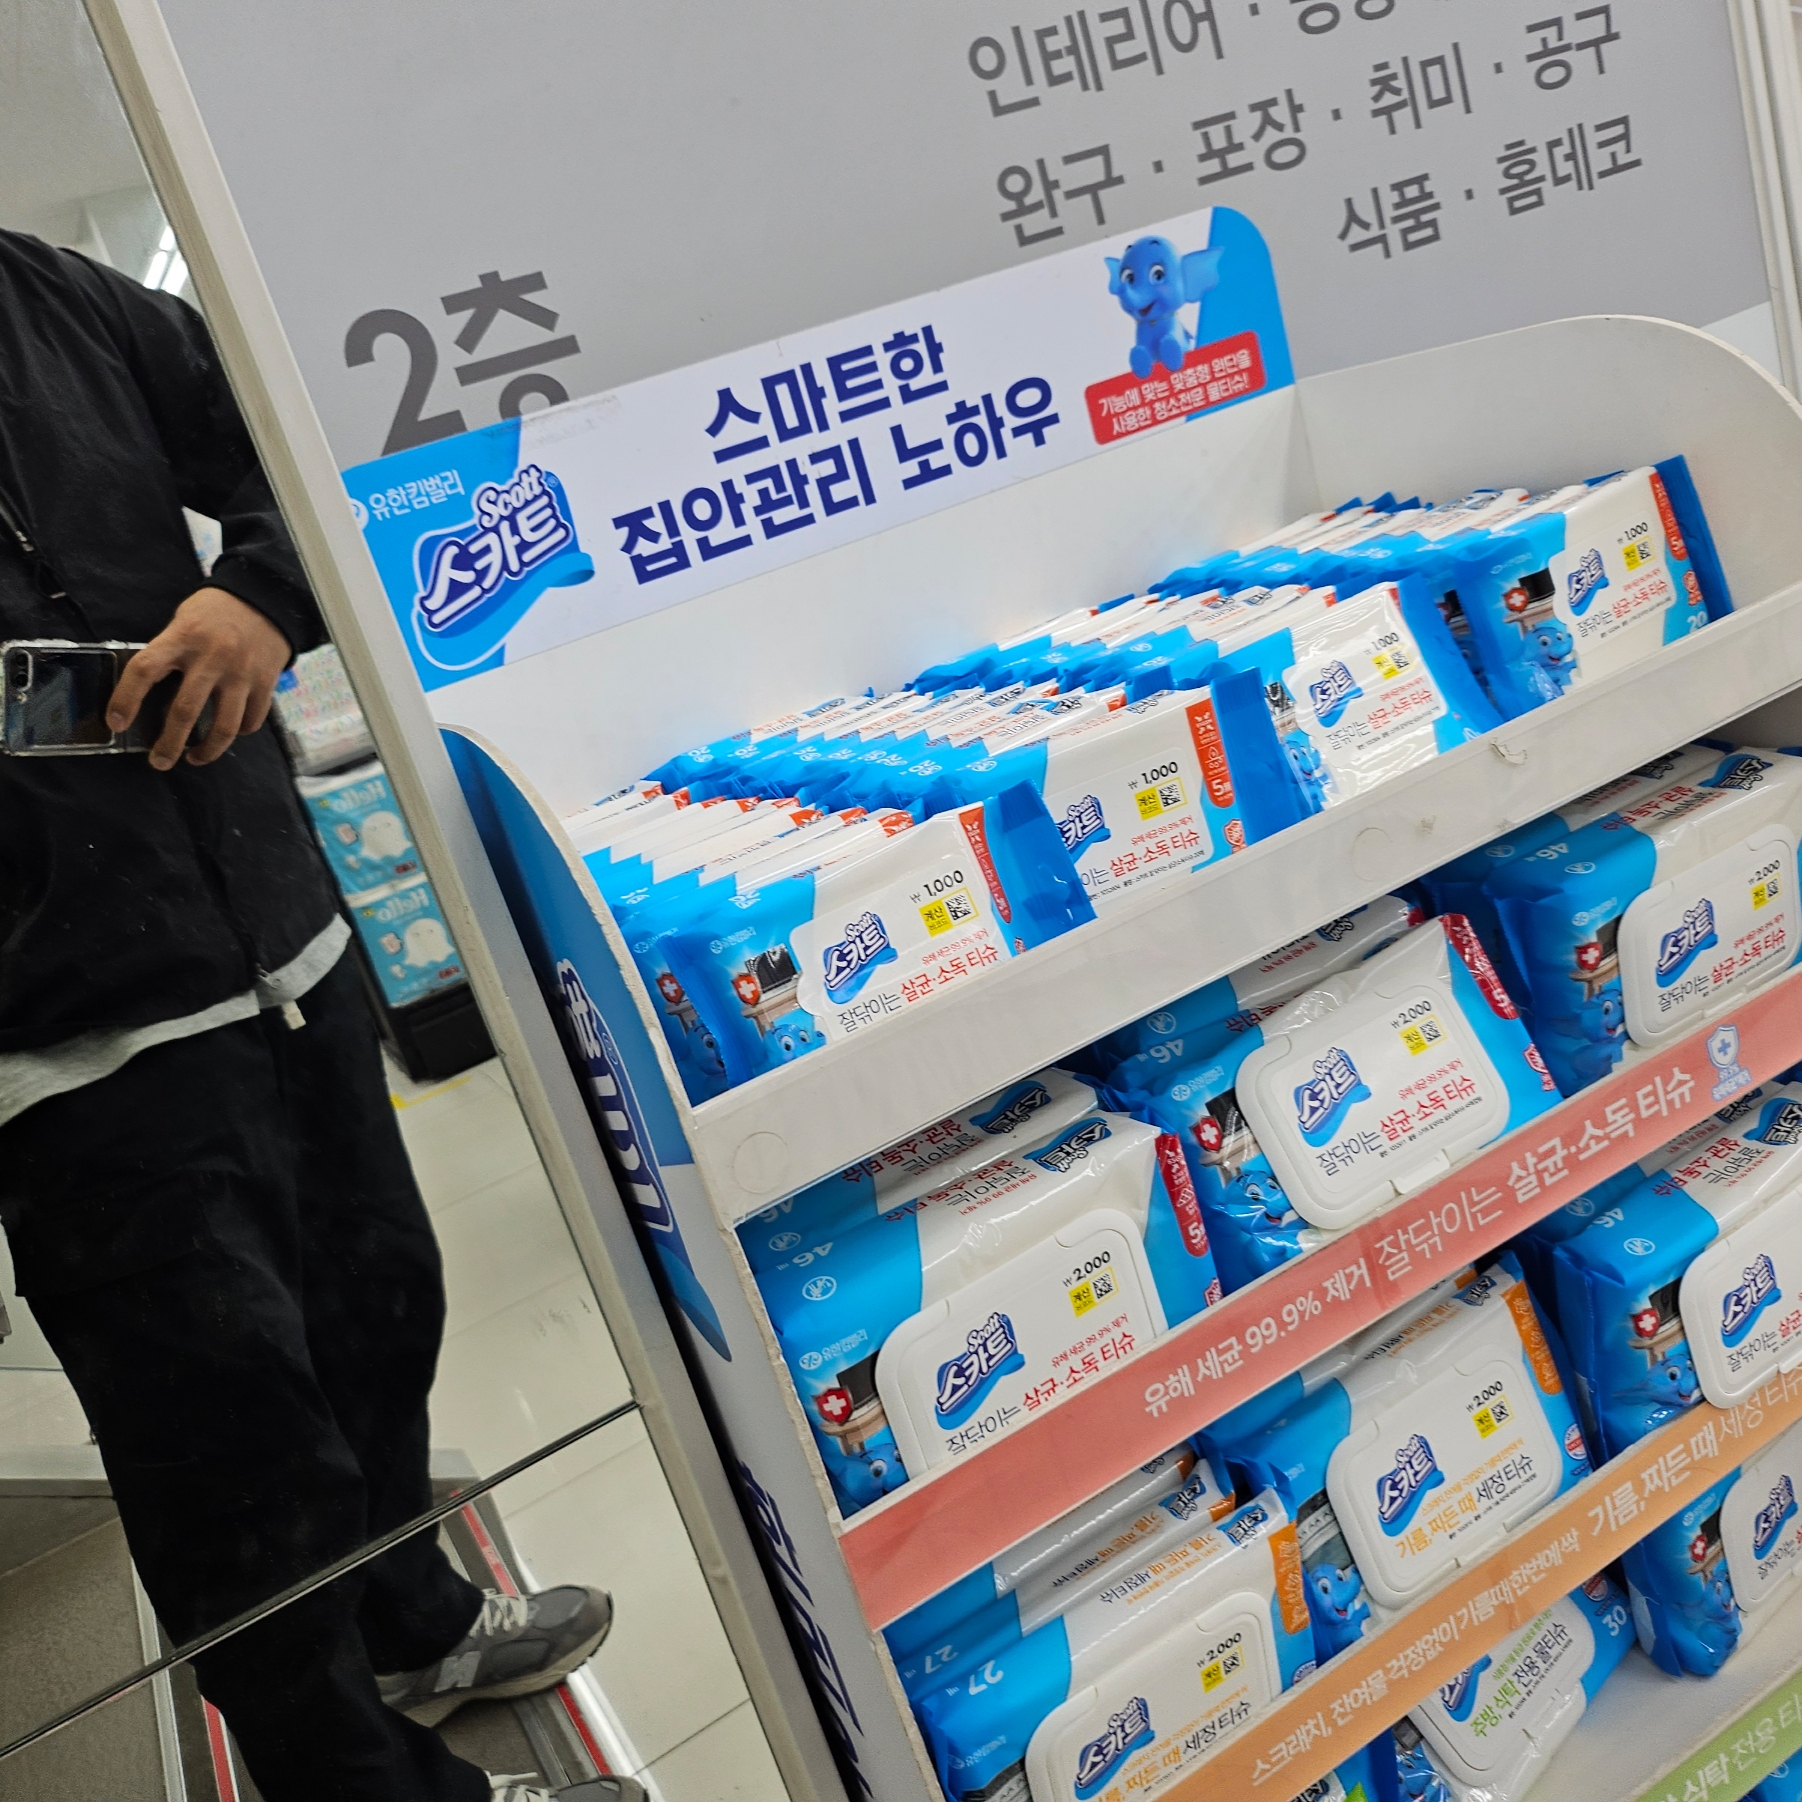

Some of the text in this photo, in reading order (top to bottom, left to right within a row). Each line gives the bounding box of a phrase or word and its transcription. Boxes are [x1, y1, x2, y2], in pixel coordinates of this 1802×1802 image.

[967, 0, 1225, 118] 인테리어
[996, 5, 1623, 248] 완구 포장 취미 공구
[1337, 115, 1643, 261] 식품 홈데코
[344, 270, 581, 457] 2층
[705, 324, 949, 464] 스마트한
[1099, 348, 1252, 417] 기능에 맞는 맞춤형 원단을
[1112, 406, 1152, 436] 사용한
[1153, 387, 1206, 420] 청소전문
[369, 469, 466, 523] 유한킴벌리
[477, 463, 544, 529] Scott
[612, 377, 1060, 585] 집안관리 노하우
[420, 493, 571, 629] 스카트
[1312, 671, 1353, 718] 스카트
[1141, 761, 1178, 785] 1,000
[1058, 808, 1104, 848] 카트
[1109, 839, 1171, 878] 살균·소독
[1171, 828, 1200, 850] 티슈
[923, 870, 964, 897] 1,000
[826, 927, 887, 990] 스카트
[1658, 911, 1715, 976] 스카트
[1762, 928, 1787, 955] 티슈
[838, 943, 999, 1033] 잘닦이는 살균·소독 티슈
[1398, 1000, 1432, 1025] 2,000
[1150, 1038, 1185, 1064] 46
[986, 1088, 1047, 1132] 스카트
[1298, 1060, 1359, 1132] 스카트
[1314, 1128, 1382, 1177] 잘닦이는
[1379, 1089, 1448, 1142] 살균·소독
[1442, 1075, 1475, 1100] 티슈
[1041, 1121, 1107, 1166] 스카트
[1374, 1185, 1503, 1282] 잘닦이는
[1506, 1098, 1637, 1205] 살균·소독
[1634, 1066, 1696, 1119] 티슈
[947, 1164, 1031, 1207] 잘닦이는
[791, 1240, 834, 1268] 46
[1072, 1250, 1112, 1282] 2,000
[967, 1312, 1001, 1352] Scott
[1721, 1267, 1775, 1334] 스카트
[1100, 1331, 1136, 1362] 티슈
[1144, 1364, 1195, 1418] 유해
[1196, 1336, 1245, 1383] 세균
[1245, 1290, 1322, 1354] 99.9%
[1322, 1257, 1372, 1302] 제거
[1726, 1330, 1779, 1373] 잘닦이는
[939, 1334, 1014, 1413] 스카트
[1378, 1446, 1434, 1521] 스카트
[1427, 1505, 1461, 1537] 찌든
[1457, 1491, 1478, 1514] 때
[1475, 1469, 1507, 1503] 세정
[1503, 1453, 1534, 1480] 티슈
[1587, 1481, 1647, 1537] 기름,
[1640, 1441, 1692, 1499] 찌든
[1689, 1420, 1720, 1468] 때
[1602, 1605, 1628, 1637] 30
[923, 1643, 959, 1675] 27
[967, 1658, 1005, 1697] 27
[1469, 1703, 1503, 1737] 주방,
[1492, 1678, 1523, 1708] 식탁
[1512, 1655, 1541, 1688] 전용
[1531, 1622, 1570, 1665] 물티슈
[1252, 1712, 1333, 1787] 스크래치,
[1330, 1669, 1391, 1727] 잔여물
[1386, 1615, 1460, 1681] 걱정없이
[1077, 1711, 1148, 1786] 스카트
[1125, 1700, 1252, 1793] 찌든 때 세정 티슈
[1682, 1717, 1779, 1802] 식탁 전용
